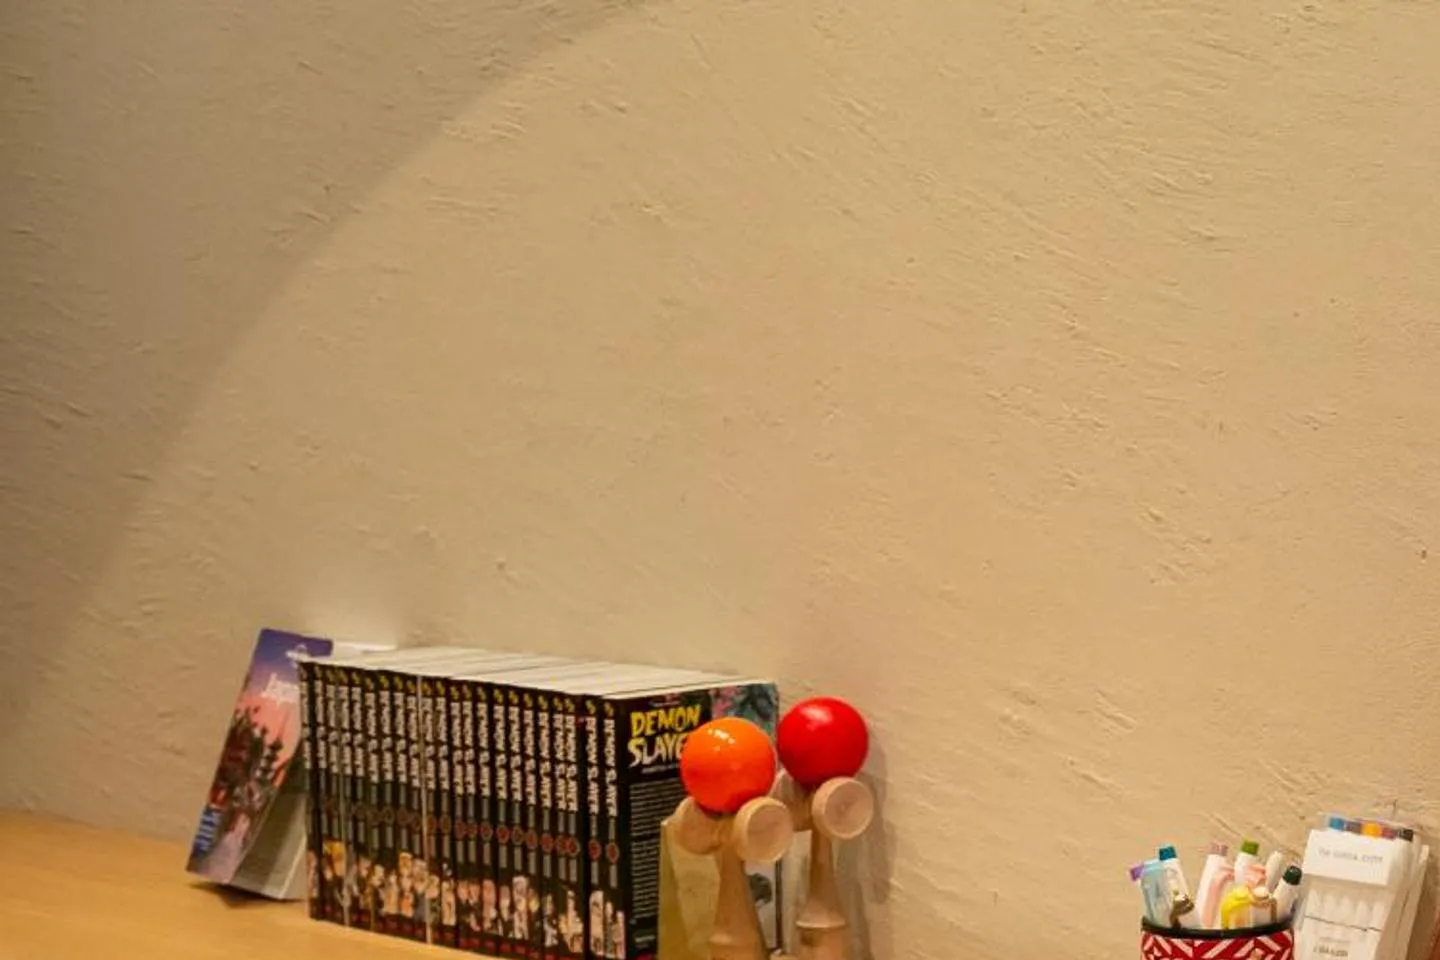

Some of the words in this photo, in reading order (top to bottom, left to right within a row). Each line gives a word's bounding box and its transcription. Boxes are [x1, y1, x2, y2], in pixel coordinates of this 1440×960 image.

[463, 700, 473, 747] DEMON
[477, 702, 488, 748] DEMON
[494, 705, 505, 752] DEMON
[509, 706, 520, 752] DEMON
[524, 709, 534, 757] DEMON
[538, 711, 550, 758] DEMON
[553, 713, 564, 760] DEMON
[565, 715, 576, 762] DEMON
[586, 716, 597, 764] DEMON
[604, 719, 615, 767] DEMON
[630, 704, 700, 737] DEMON
